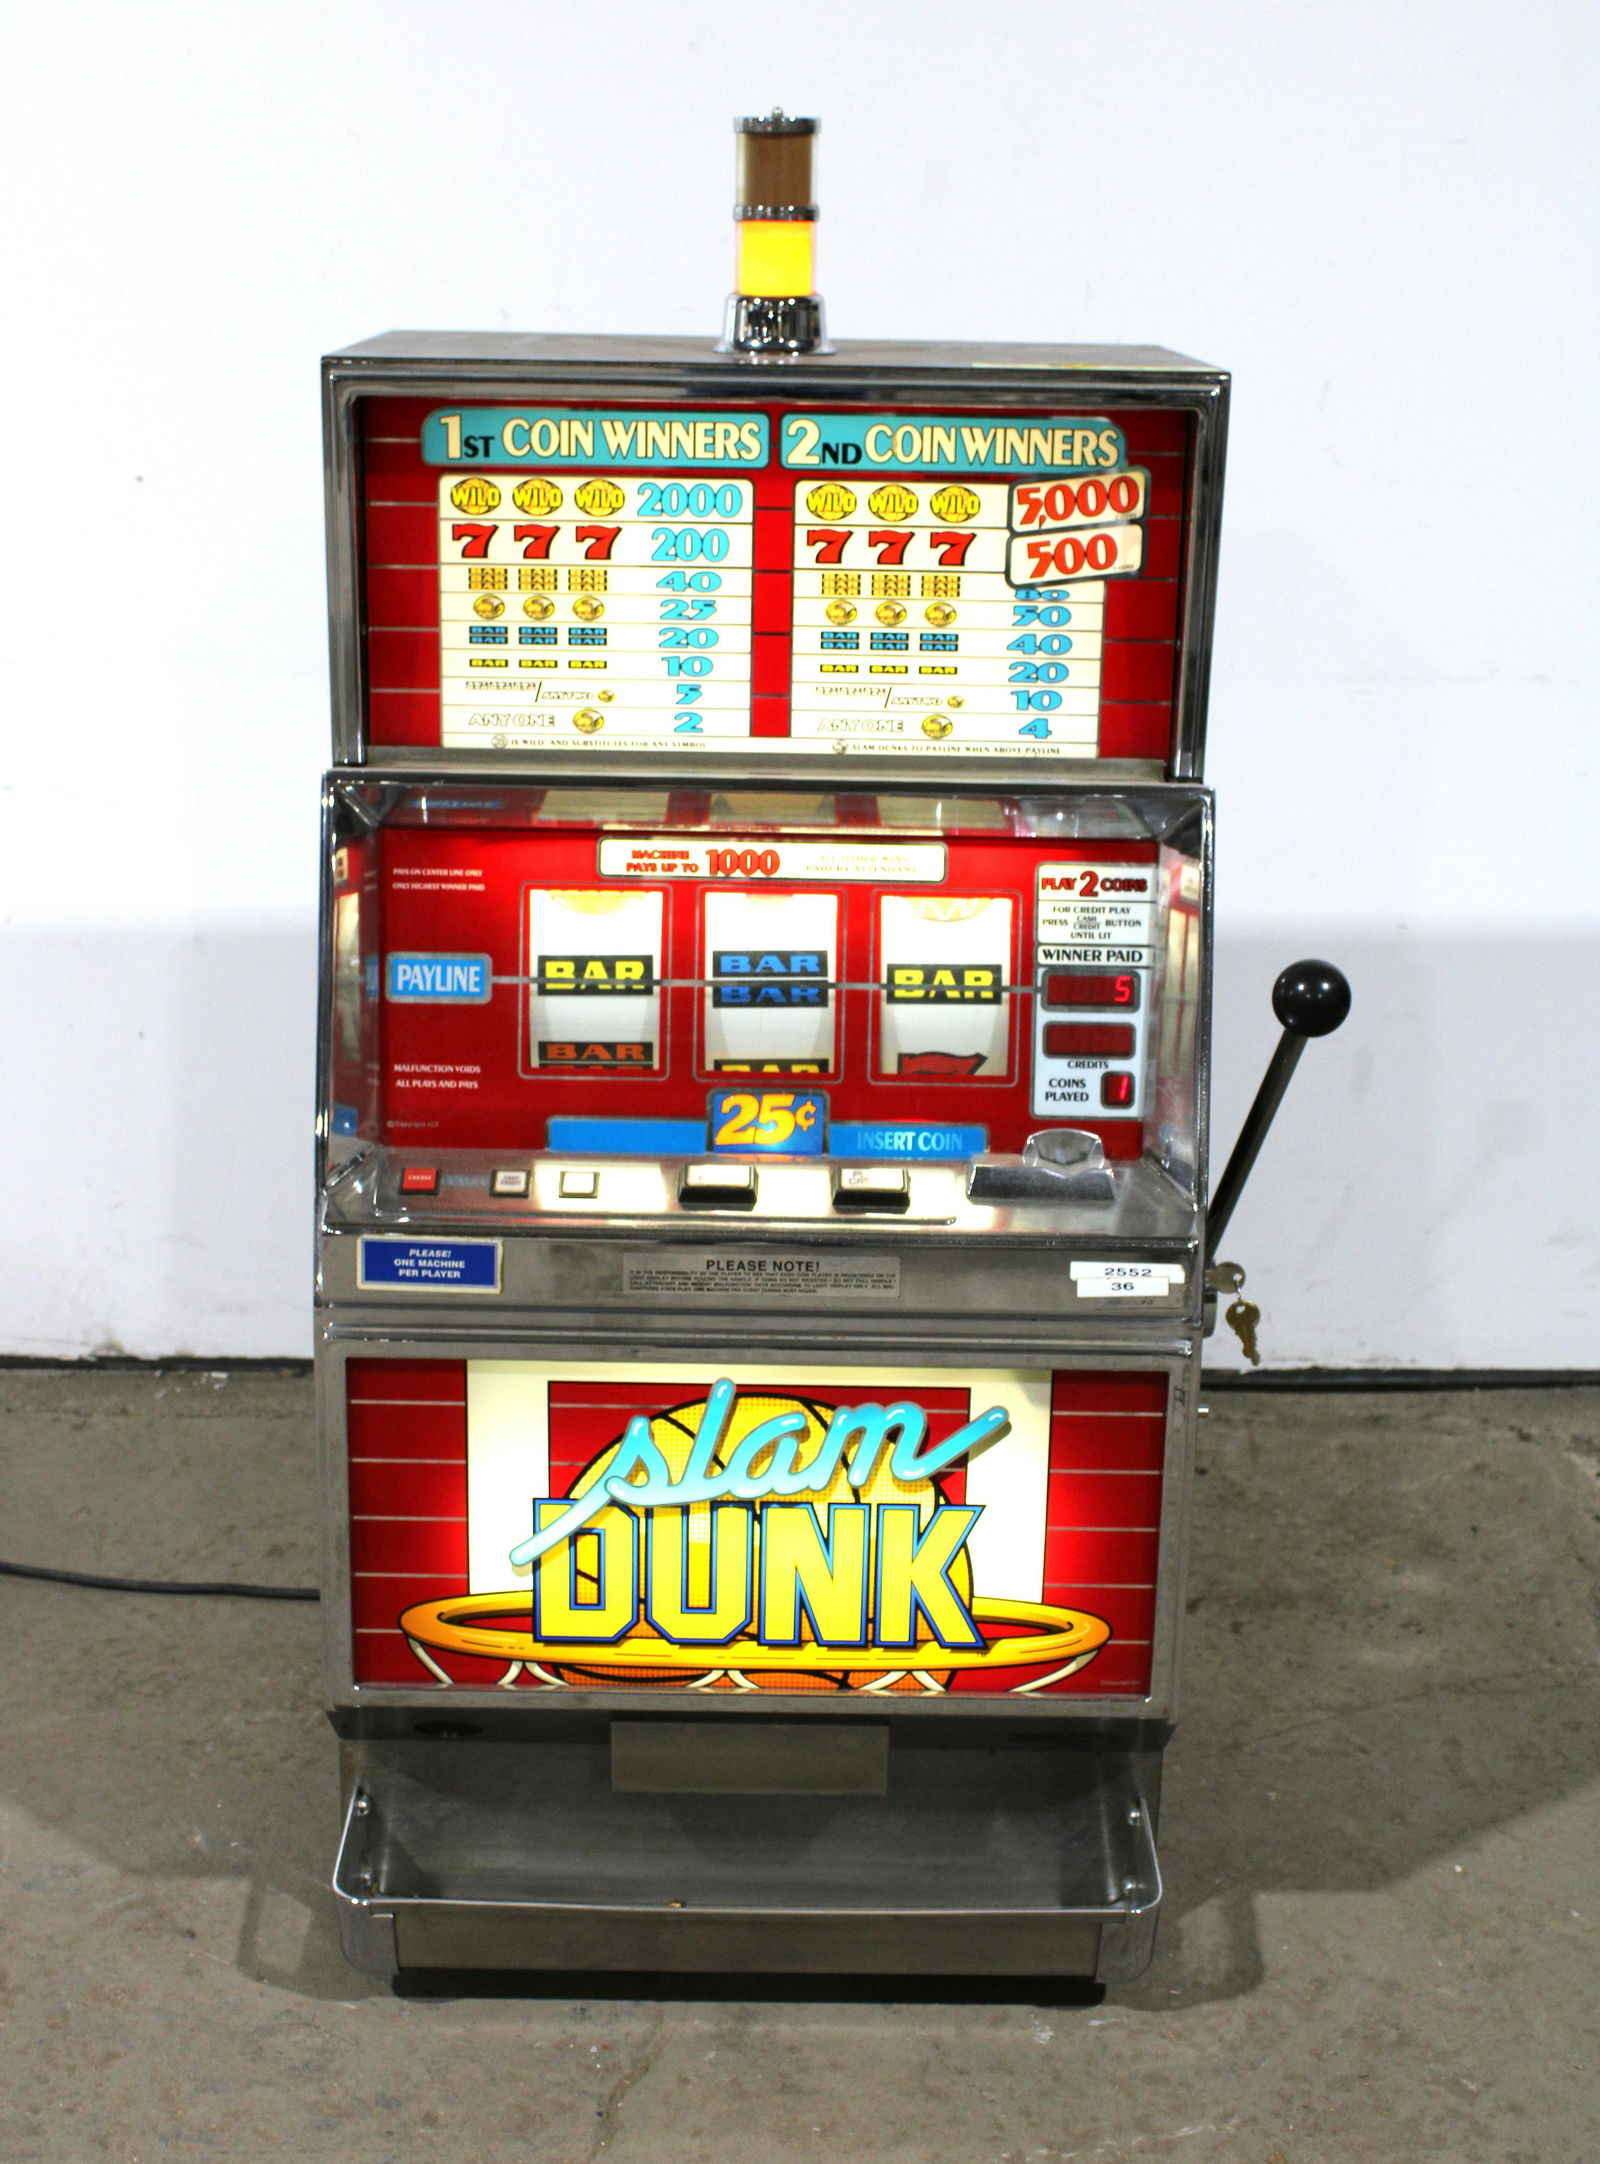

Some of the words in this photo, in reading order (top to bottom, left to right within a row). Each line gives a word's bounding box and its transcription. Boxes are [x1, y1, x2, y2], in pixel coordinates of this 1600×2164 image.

[439, 414, 495, 459] 1ST
[501, 417, 595, 458] COIN
[601, 420, 762, 461] WINNERS
[786, 418, 862, 466] 2ND
[864, 423, 957, 464] COIN
[960, 426, 1119, 468] WINNERS
[450, 486, 502, 506] WILD
[512, 487, 563, 507] WILD
[574, 488, 625, 508] WILD
[637, 482, 743, 518] 2000
[806, 492, 858, 512] WILD
[868, 493, 919, 513] WILD
[930, 494, 981, 514] WILD
[1016, 475, 1140, 529] 5,000
[452, 523, 499, 559] 7
[514, 524, 561, 559] 7
[575, 525, 622, 560] 7
[651, 527, 730, 562] 200
[806, 529, 854, 564] 7
[868, 530, 916, 565] 7
[930, 531, 977, 566] 7
[1027, 534, 1118, 579] 500
[656, 571, 722, 592] 40
[660, 599, 717, 620] 25
[1012, 605, 1071, 627] 50
[659, 627, 719, 649] 20
[1007, 633, 1073, 655] 40
[661, 656, 713, 677] 10
[1008, 661, 1069, 684] 20
[676, 684, 702, 705] 5
[1010, 690, 1063, 711] 10
[468, 712, 511, 727] ANY
[513, 713, 556, 727] ONE
[674, 712, 704, 733] 2
[817, 719, 860, 732] ANY
[862, 719, 904, 732] ONE
[1019, 718, 1052, 739] 4
[661, 863, 679, 873] UP
[681, 863, 699, 873] TO
[705, 849, 780, 876] 1000
[1041, 877, 1077, 891] PLAY
[1079, 870, 1099, 897] 2
[1100, 877, 1148, 893] COINS
[1073, 906, 1106, 914] CREDIT
[1108, 906, 1132, 914] PLAY
[1105, 919, 1142, 927] BUTTON
[1070, 932, 1096, 940] UNTIL
[1098, 932, 1113, 940] LIT
[720, 955, 820, 973] BAR
[1042, 949, 1102, 962] WINNER
[1106, 950, 1143, 962] PAID
[396, 963, 481, 993] PAYLINE
[545, 960, 645, 990] BAR
[894, 969, 994, 998] BAR
[720, 986, 820, 1004] BAR
[1113, 975, 1132, 1002] 5
[546, 1043, 646, 1060] BAR
[394, 1064, 454, 1073] MALFUNCTION
[455, 1065, 481, 1074] VOIDS
[1067, 1061, 1109, 1069] CREDITS
[438, 1080, 458, 1088] AND
[1048, 1078, 1087, 1088] COINS
[1045, 1091, 1089, 1102] PLAYED
[715, 1093, 816, 1145] 25¢
[857, 1131, 916, 1151] INSERT
[917, 1132, 963, 1151] COIN
[409, 1248, 452, 1258] PLEASE!
[394, 1259, 416, 1267] ONE
[418, 1259, 466, 1269] MACHINE
[399, 1268, 419, 1278] PER
[421, 1269, 461, 1279] PLAYER
[706, 1259, 767, 1272] PLEASE
[772, 1260, 820, 1273] NOTE!
[1104, 1267, 1152, 1277] 2552
[1111, 1282, 1135, 1291] 36
[509, 1377, 1009, 1567] slam
[532, 1497, 988, 1651] DUNK
